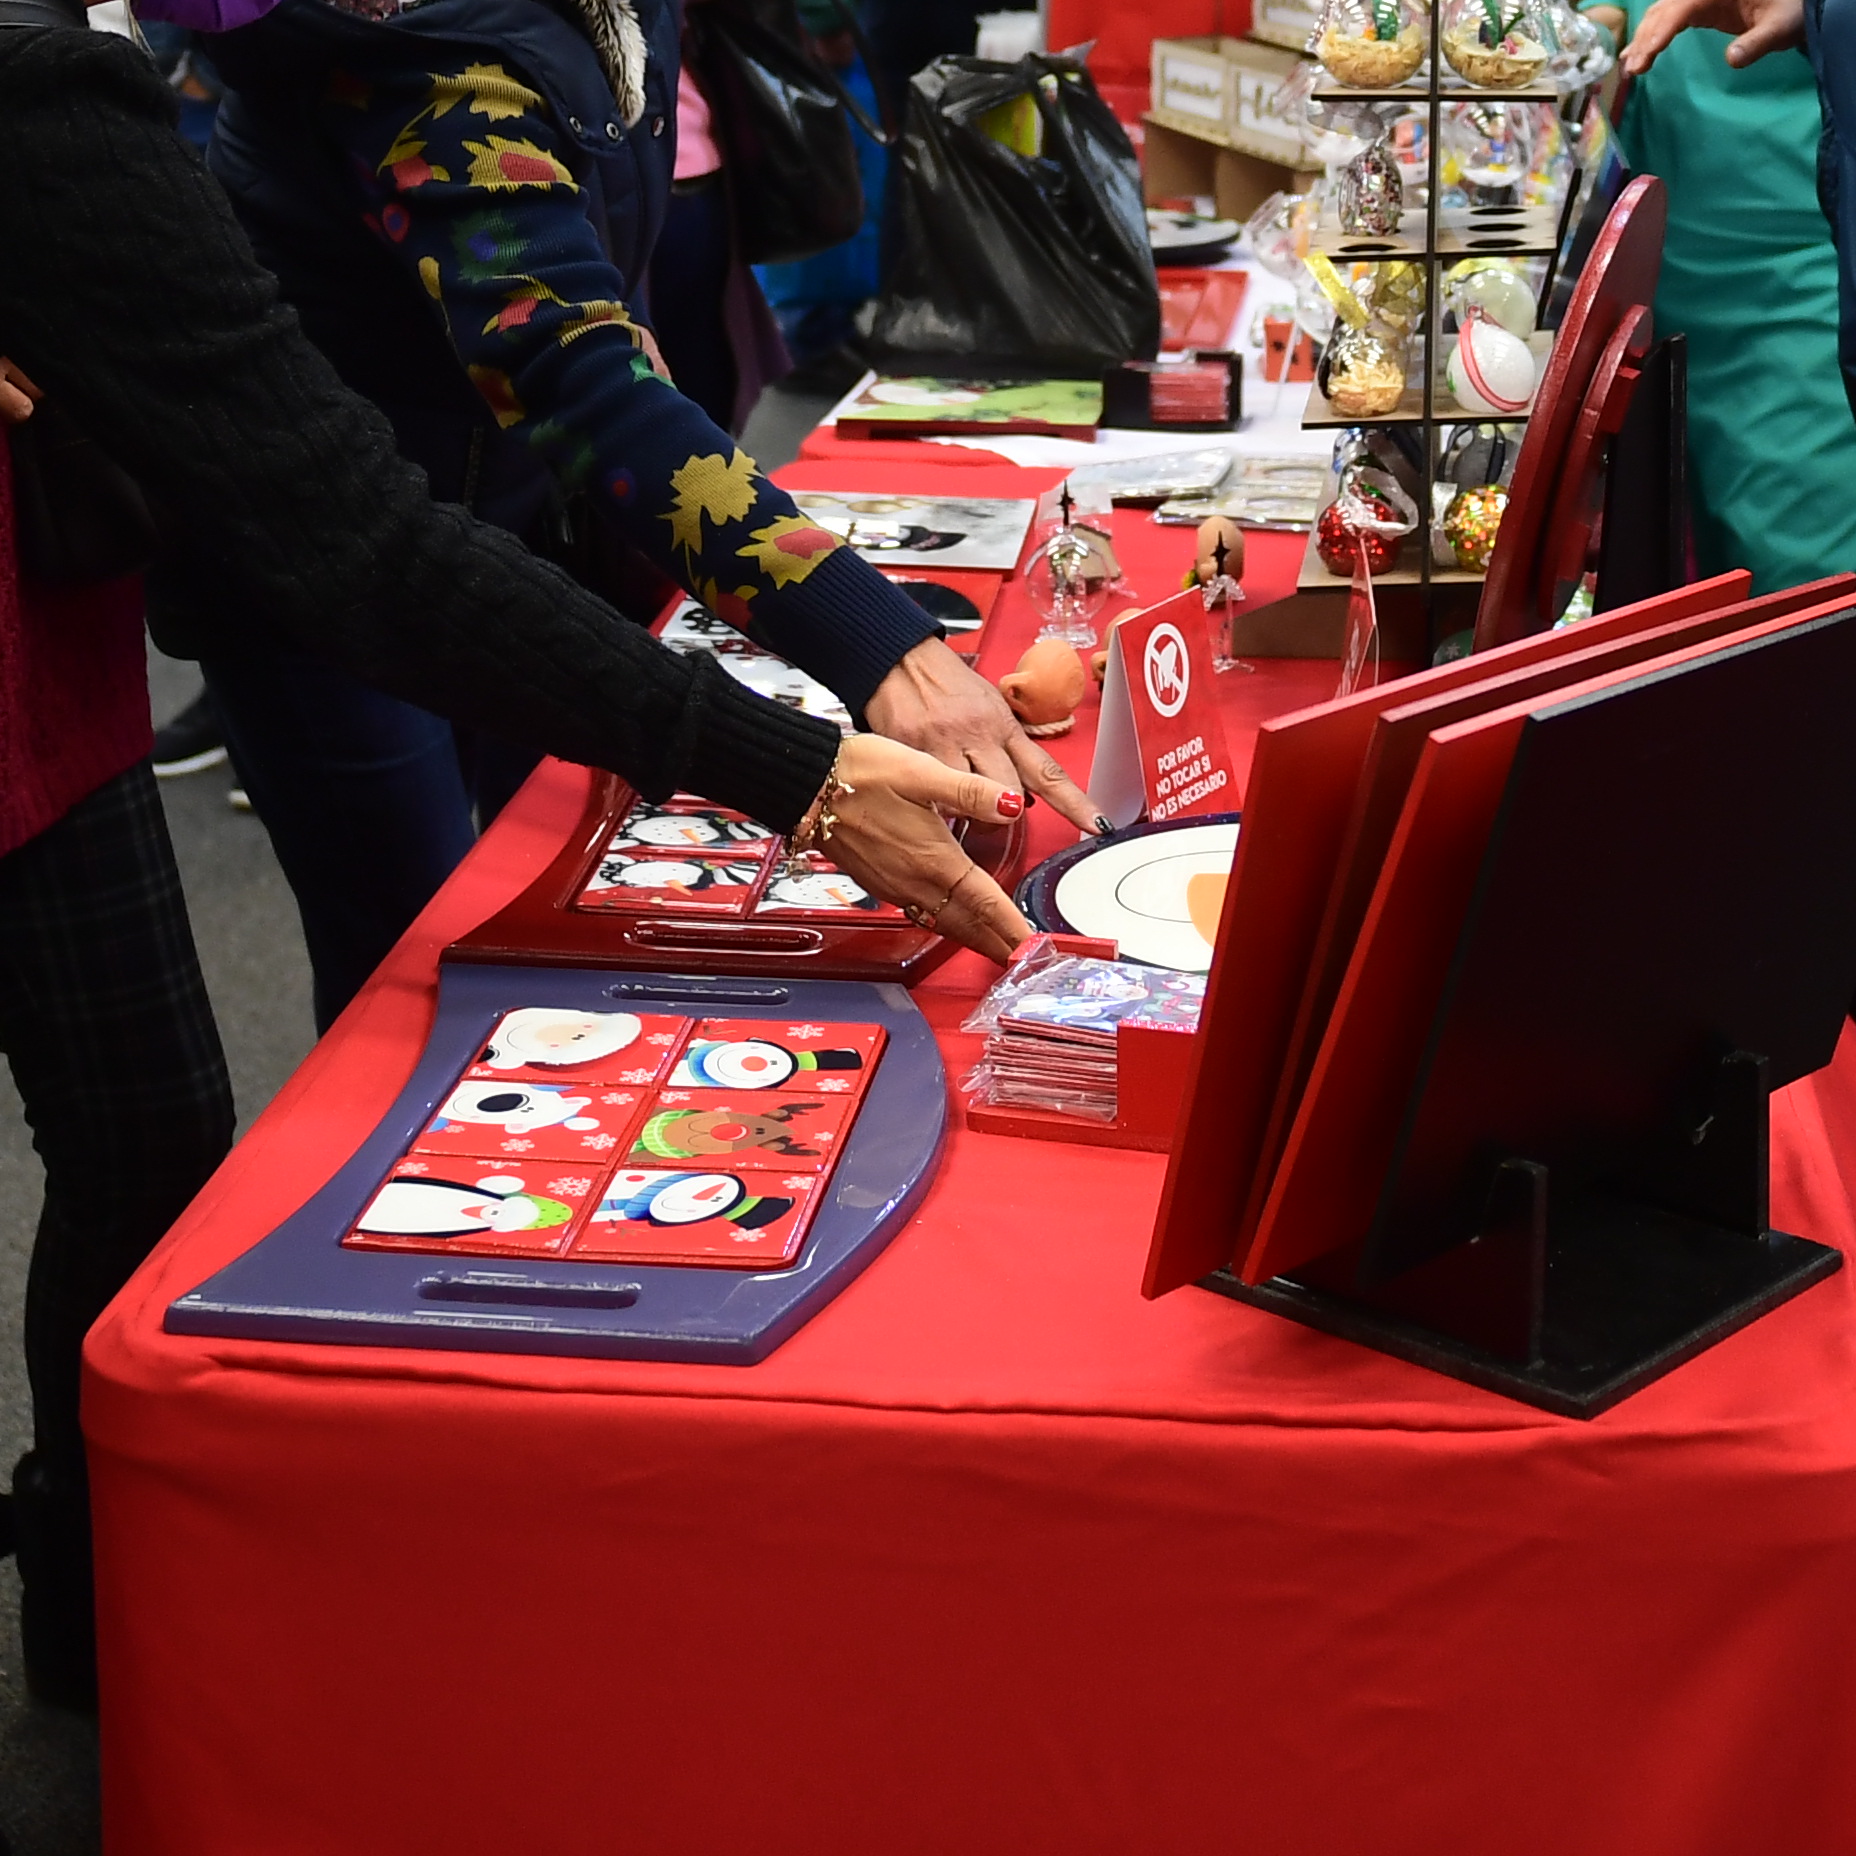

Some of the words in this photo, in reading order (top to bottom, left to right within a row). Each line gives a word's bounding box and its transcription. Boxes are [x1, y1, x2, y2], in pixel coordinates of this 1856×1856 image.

[1156, 777, 1171, 799] NO
[1170, 759, 1203, 789] TOCAR
[1201, 753, 1212, 772] SI
[1157, 750, 1177, 775] POR
[1176, 736, 1204, 764] FAVOR
[1151, 802, 1167, 822] NO
[1166, 795, 1178, 815] ES
[1177, 769, 1228, 810] NECESARIO
